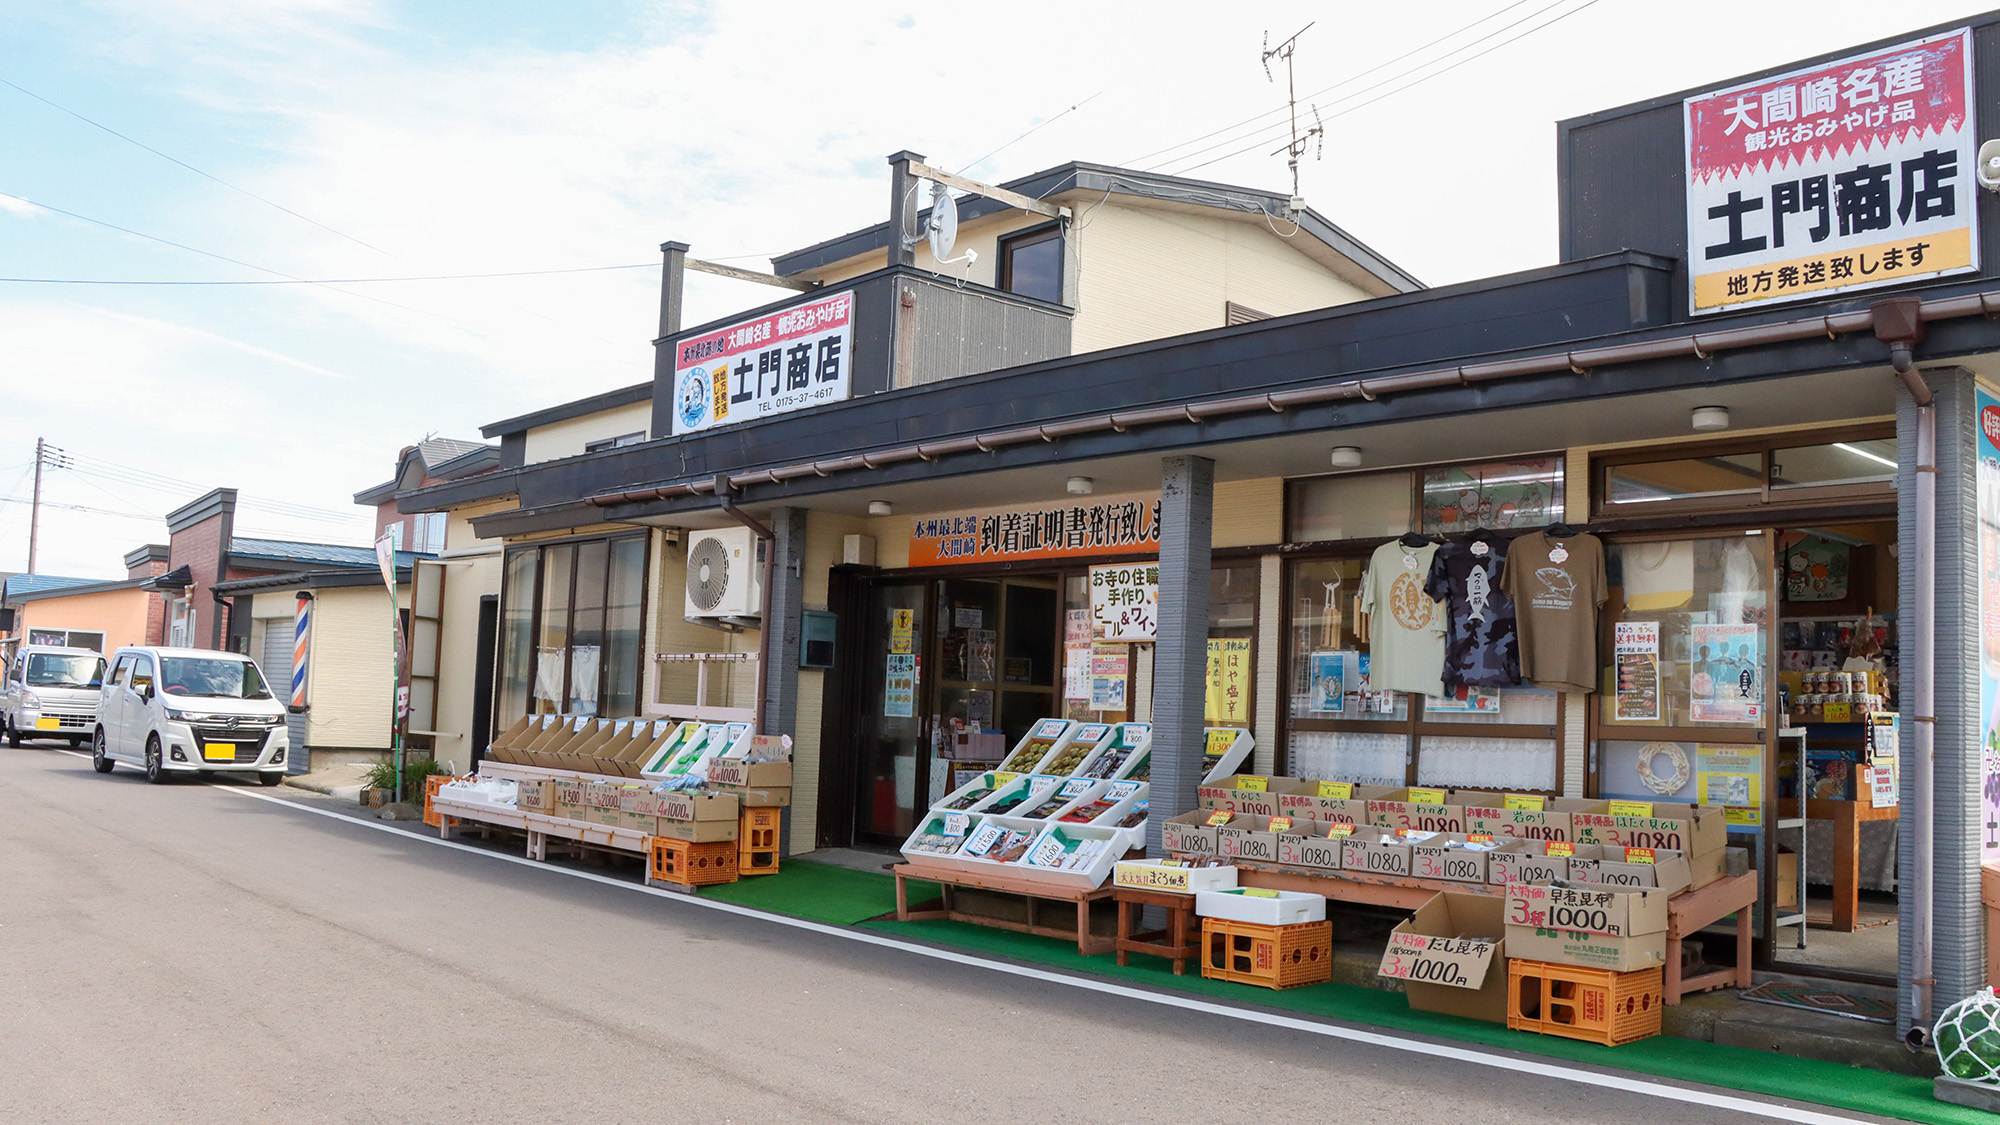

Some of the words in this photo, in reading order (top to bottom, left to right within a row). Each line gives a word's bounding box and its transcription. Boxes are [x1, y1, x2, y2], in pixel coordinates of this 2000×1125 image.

[1723, 56, 1925, 136] 大間崎名産
[1744, 99, 1916, 153] 観光おみやげ品
[1705, 149, 1957, 260] 土門商店
[1726, 242, 1931, 297] 地方発送致します
[727, 321, 772, 350] 大間崎名産
[777, 300, 847, 336] 観光おみやげ品
[731, 335, 842, 404] 土門商店
[758, 403, 772, 412] TEL
[776, 387, 834, 408] 0175-37-4617
[914, 516, 977, 539] 本州最北端
[937, 537, 976, 559] 大間崎
[1092, 568, 1159, 587] お寺の住職
[1108, 588, 1145, 606] 手作り
[1121, 612, 1130, 625] &
[1616, 634, 1657, 644] 送料無料
[1226, 654, 1239, 720] ほや塩辛
[1198, 787, 1227, 799] お買得品
[1281, 796, 1313, 807] お買得品
[1320, 799, 1346, 810] ひじき
[1369, 801, 1406, 813] お買得品
[1416, 804, 1448, 816] わかめ
[1467, 807, 1501, 819] お買得品
[1513, 811, 1546, 825] 岩のり
[1163, 823, 1182, 833] よりどり
[1573, 815, 1614, 827] お買得品
[1218, 828, 1240, 839] よりどり
[1280, 834, 1301, 845] よりどり
[1343, 839, 1366, 850] よりどり
[1415, 846, 1442, 858] よりどり
[1367, 851, 1406, 874] 1080円
[1490, 852, 1515, 863] よりどり
[1149, 870, 1186, 887] まぐろ佃煮
[1443, 859, 1481, 880] 1080円
[1508, 885, 1545, 899] 大特価
[1551, 888, 1609, 907] 早煮昆布
[1511, 898, 1546, 927] 3袋
[1549, 905, 1620, 936] 1000円
[1392, 933, 1427, 948] 大特価
[1427, 937, 1489, 959] だし昆布
[1382, 955, 1411, 978] 3袋
[1410, 958, 1467, 986] 1000円
